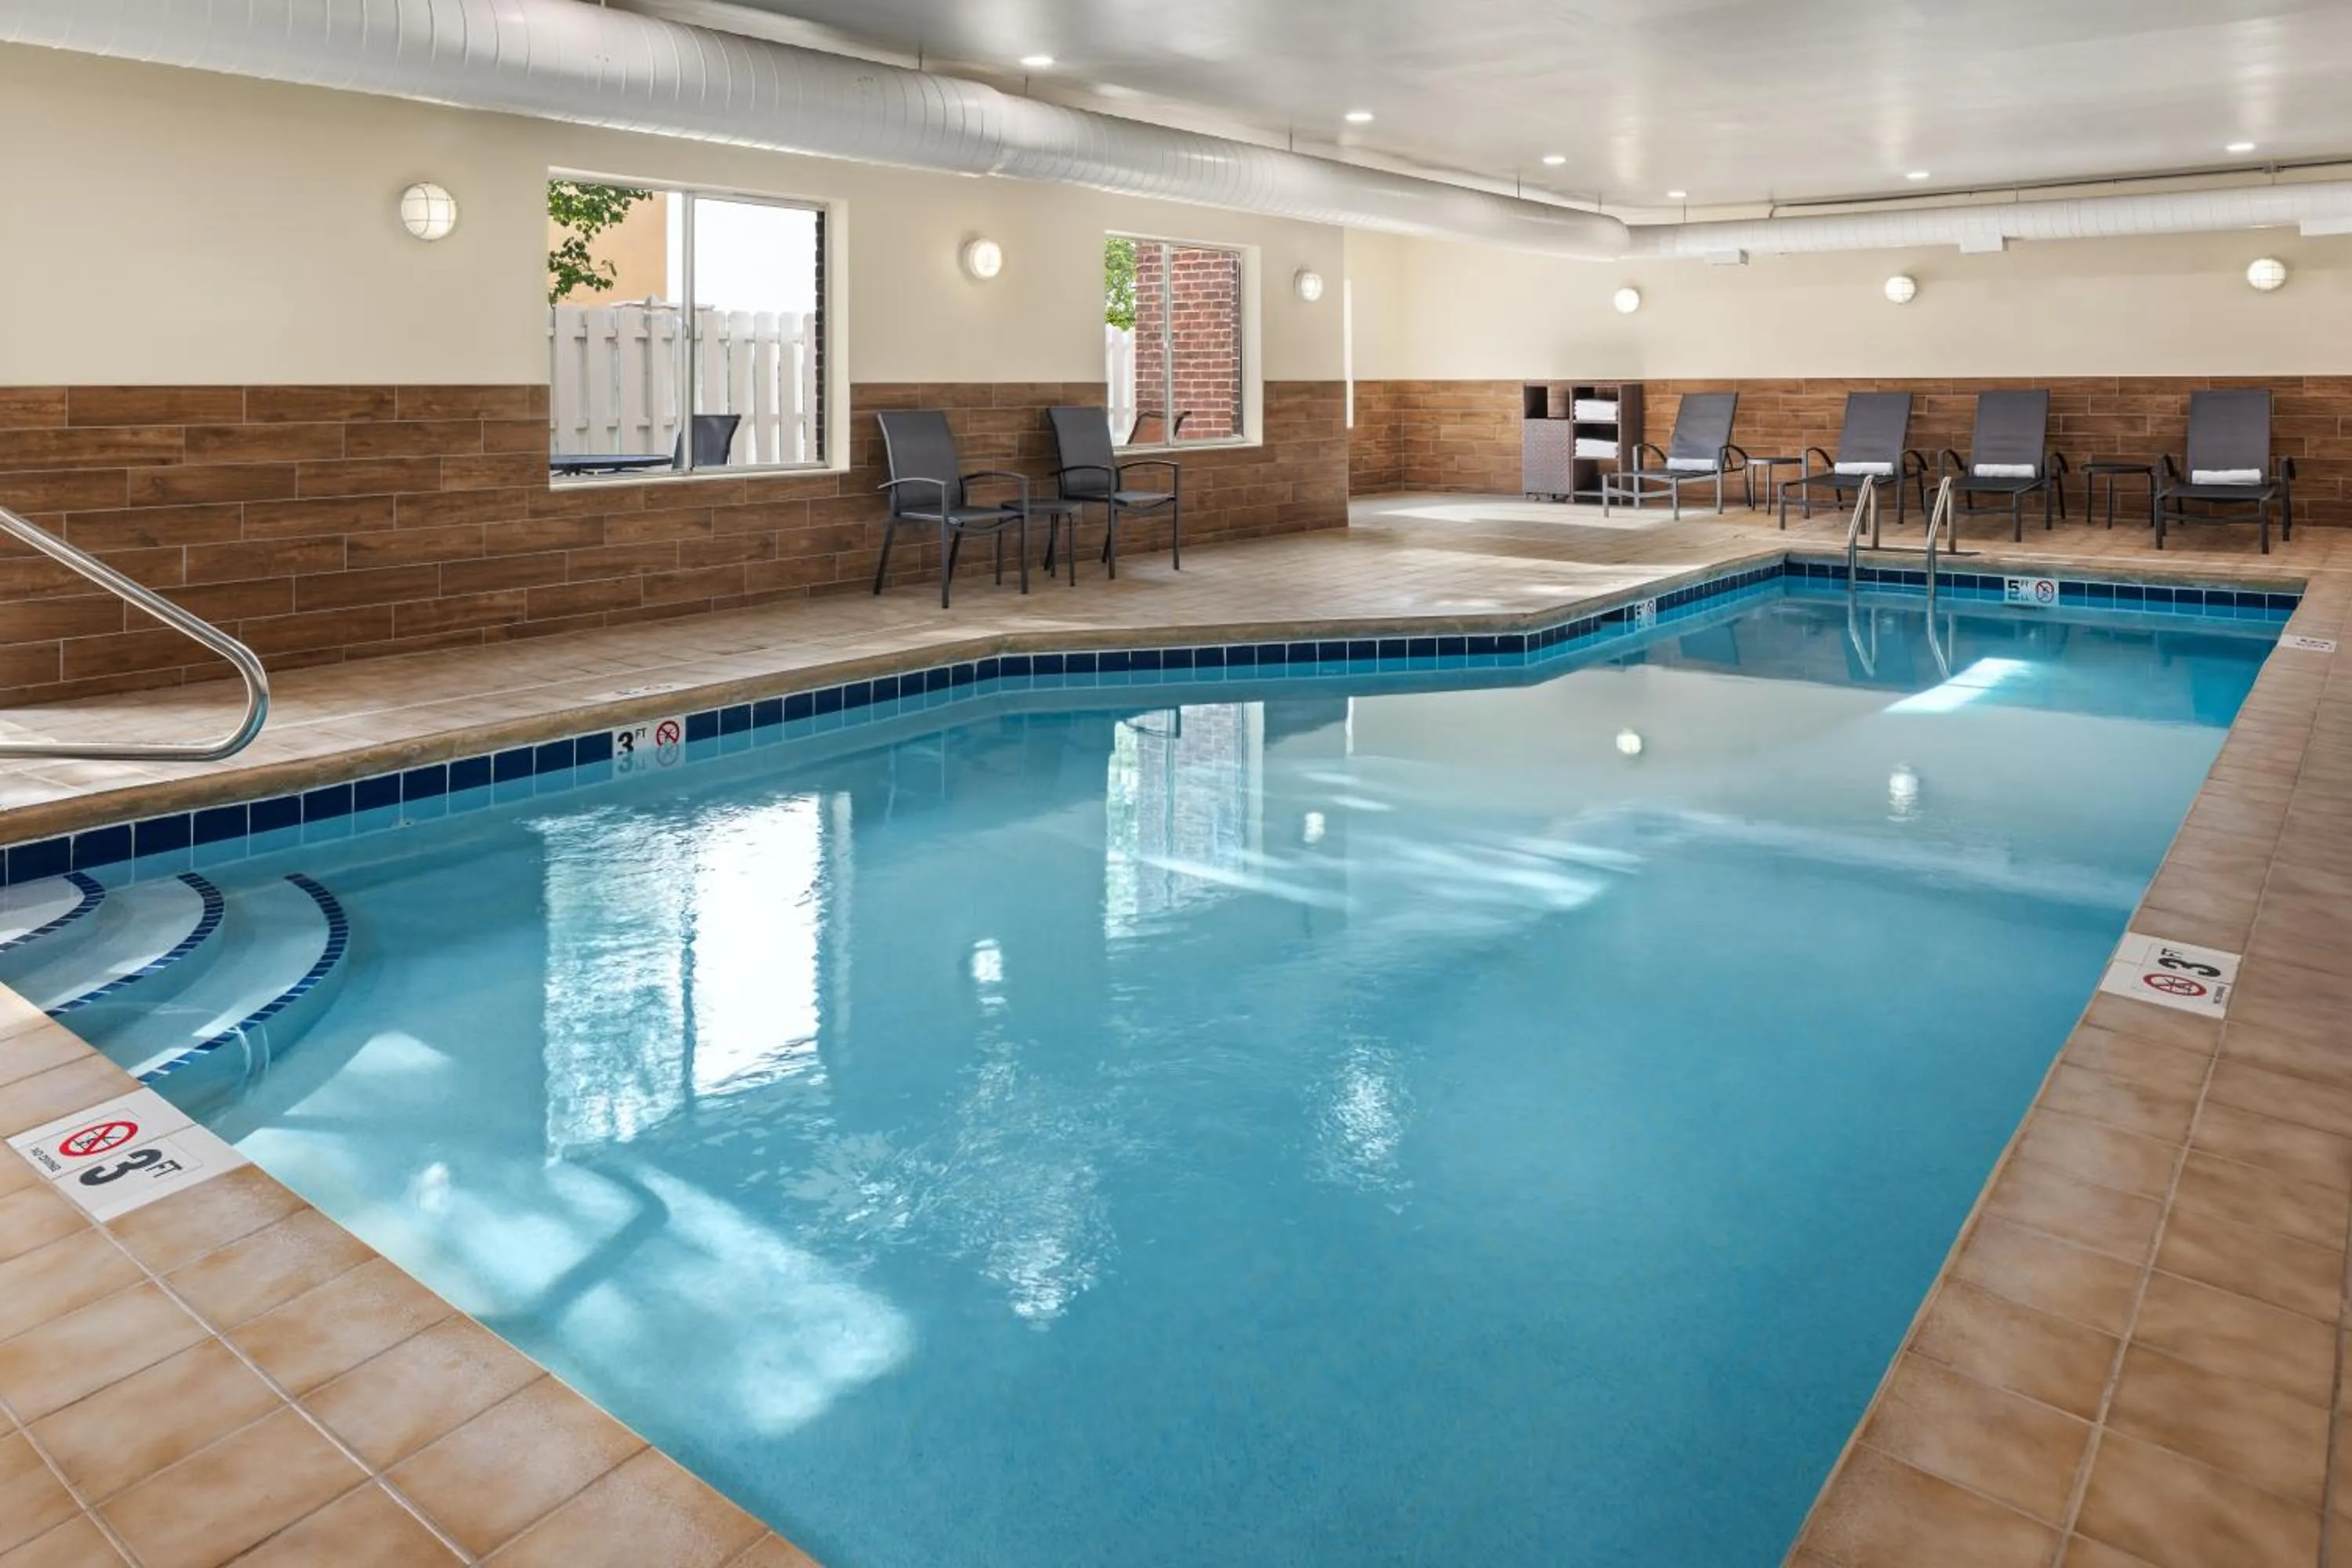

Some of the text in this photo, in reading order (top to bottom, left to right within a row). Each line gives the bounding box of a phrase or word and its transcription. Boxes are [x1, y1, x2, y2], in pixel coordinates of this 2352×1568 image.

[617, 728, 647, 755] 3 FT
[2158, 948, 2221, 977] 3 FT
[79, 1149, 183, 1185] 3 FT
